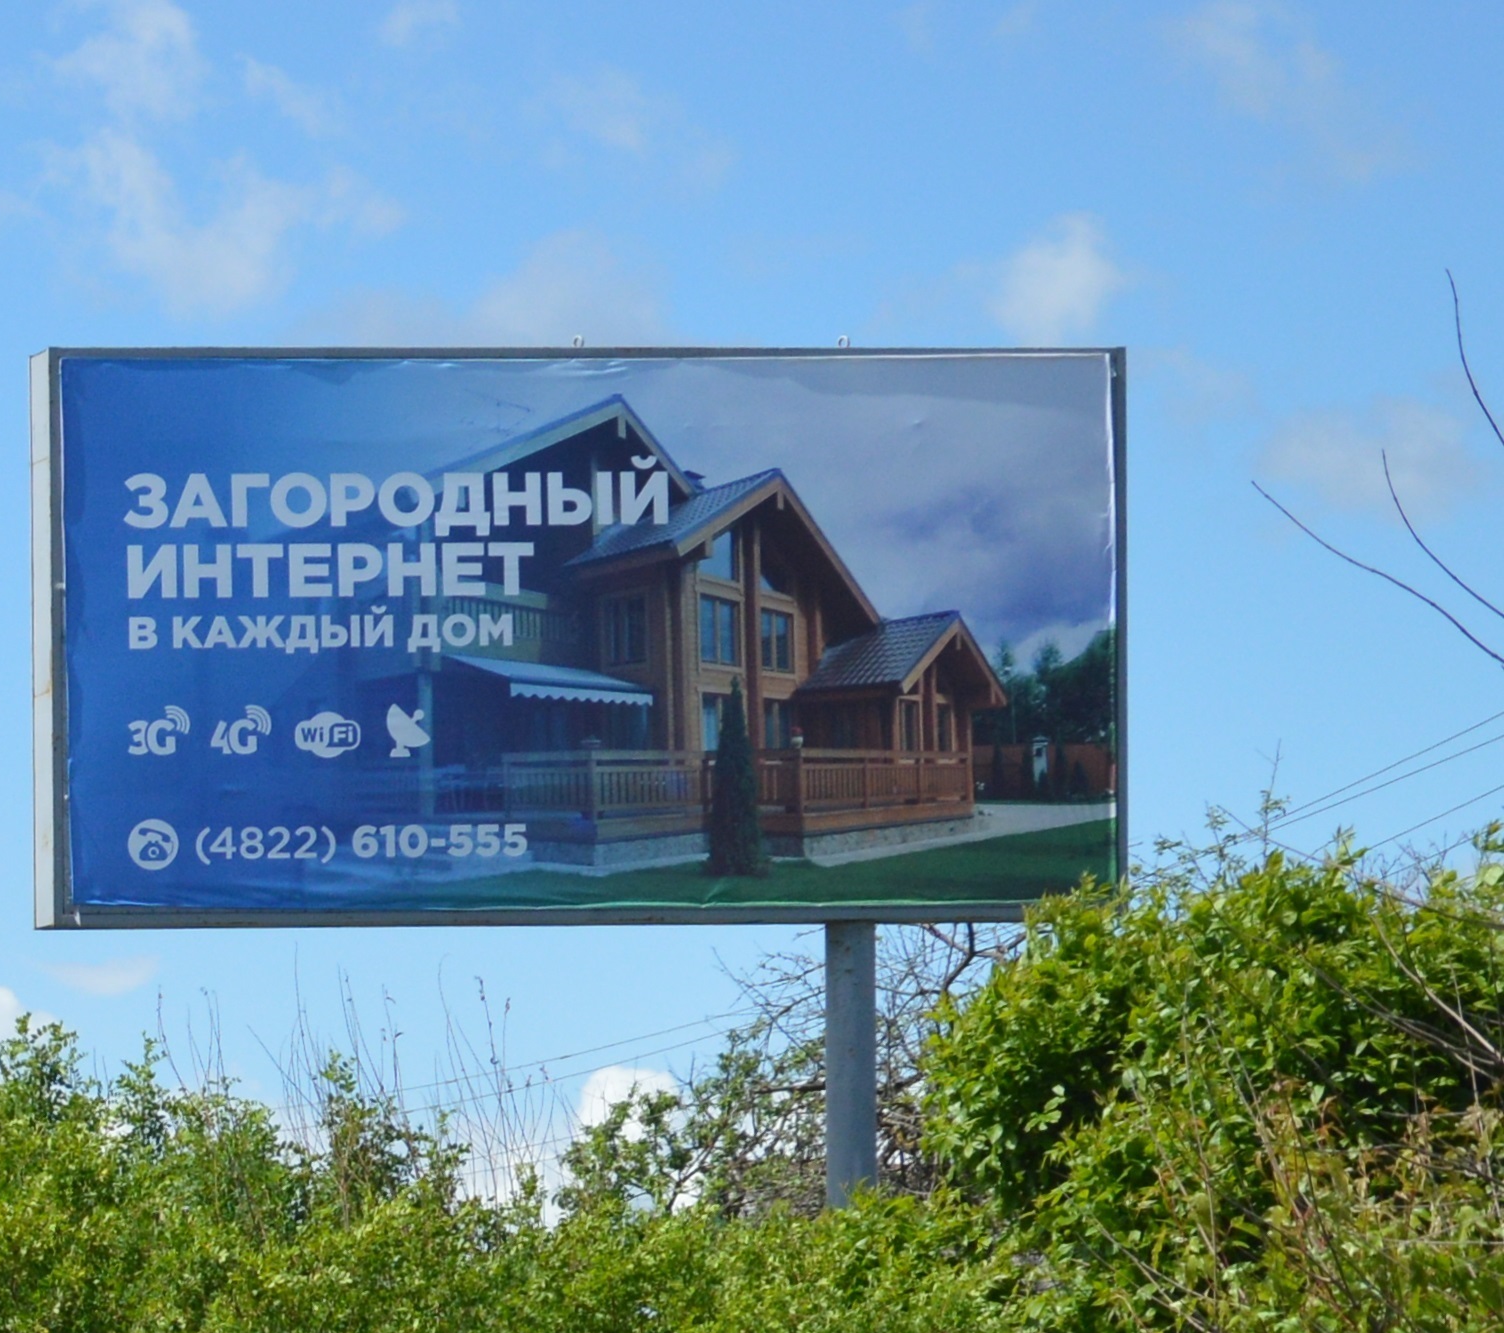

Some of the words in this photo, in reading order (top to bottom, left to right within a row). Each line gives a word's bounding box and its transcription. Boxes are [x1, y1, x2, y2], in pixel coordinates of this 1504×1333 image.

[123, 455, 670, 537] ЗАГОРОДНЫЙ
[126, 542, 534, 599] ИНТЕРНЕТ
[128, 616, 158, 650] В
[172, 605, 394, 654] КАЖДЫЙ
[407, 614, 513, 653] ДОМ
[127, 719, 176, 756] 3G
[210, 718, 258, 755] 4G
[195, 825, 336, 866] (4822)
[352, 823, 528, 858] 610-555
